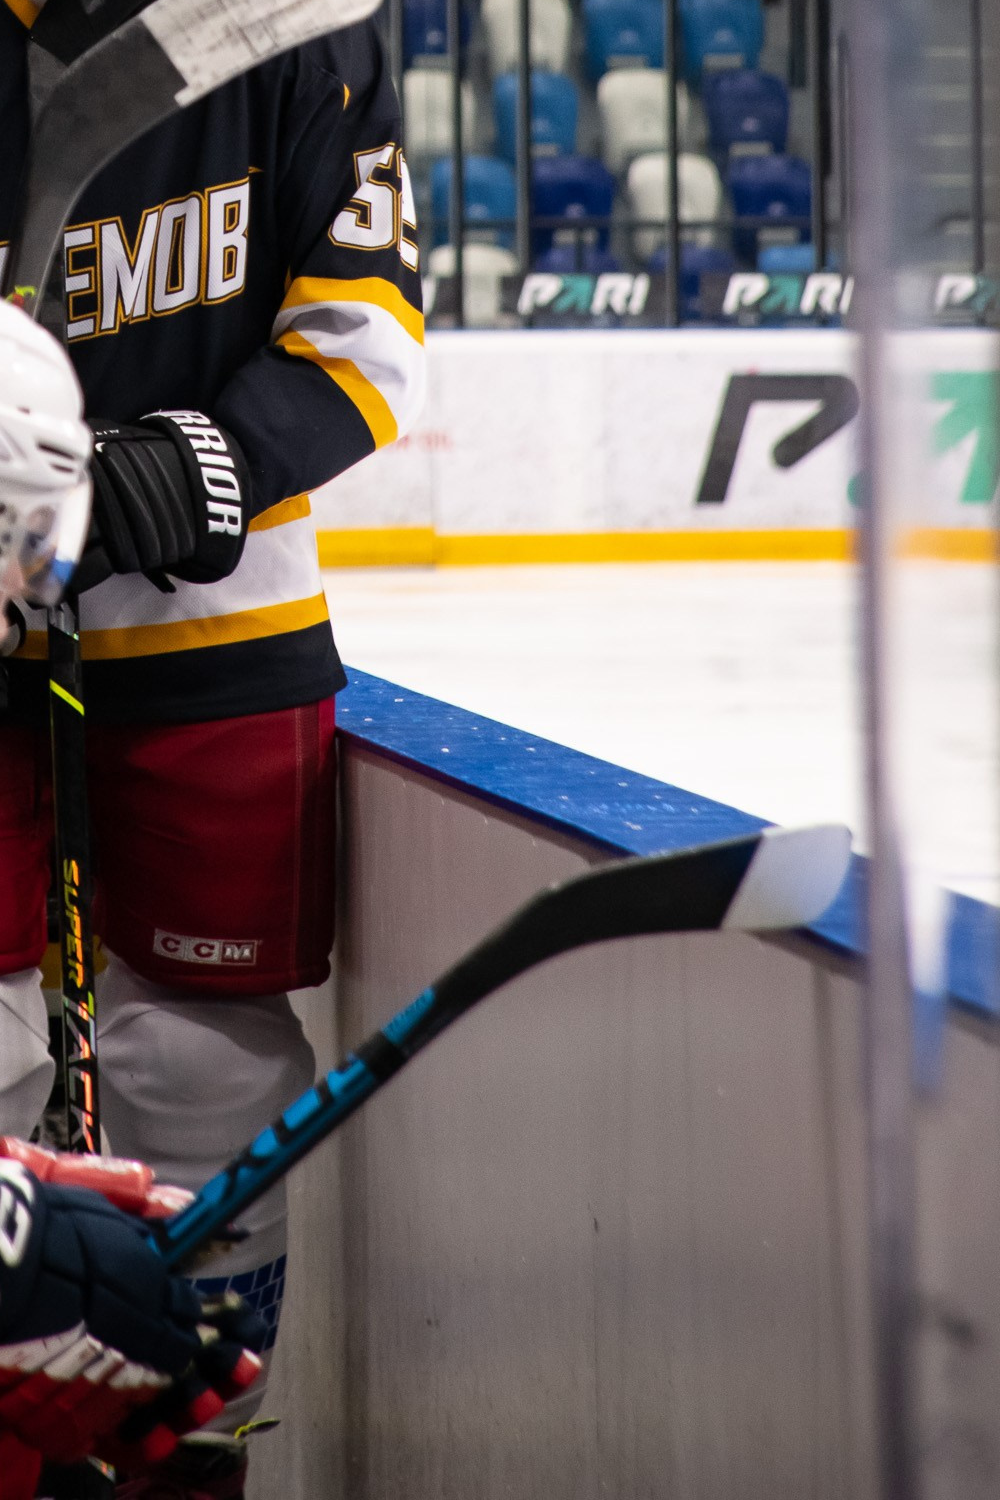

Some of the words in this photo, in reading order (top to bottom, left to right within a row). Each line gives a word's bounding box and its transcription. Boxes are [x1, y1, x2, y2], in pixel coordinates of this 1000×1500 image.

[517, 272, 650, 316] PARI
[156, 932, 256, 964] CCM
[63, 990, 97, 1156] TACK
